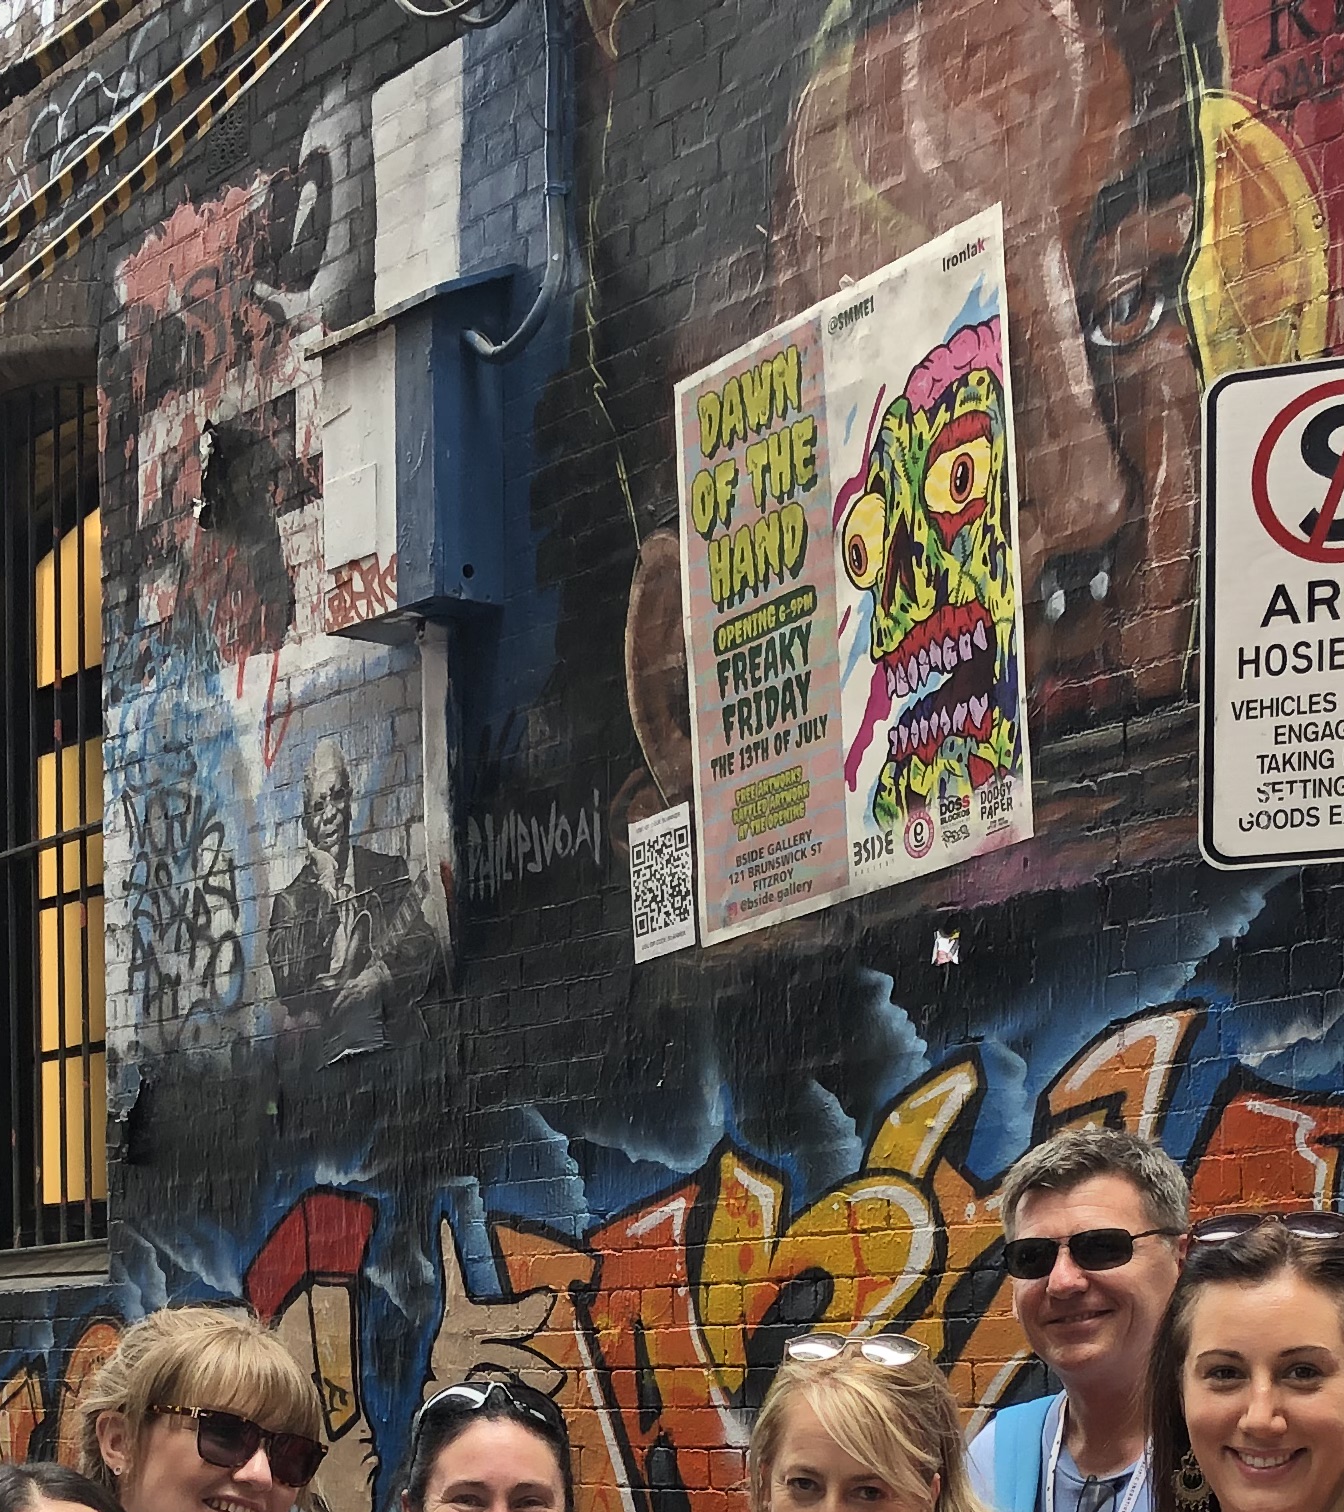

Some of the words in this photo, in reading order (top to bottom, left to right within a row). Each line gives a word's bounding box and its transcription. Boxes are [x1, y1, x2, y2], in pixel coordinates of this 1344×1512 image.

[941, 237, 986, 272] Ironlak
[697, 344, 802, 459] DAWN
[691, 457, 739, 540] OF
[745, 416, 818, 513] THE
[708, 502, 808, 613] HAND
[718, 605, 776, 651] OPENING
[717, 619, 813, 702] FREAKY
[722, 669, 812, 747] FRIDAY
[1231, 692, 1337, 721] VEHICLES
[710, 751, 735, 781] THE
[739, 736, 769, 771] 13TH
[773, 729, 791, 756] OF
[795, 713, 828, 749] JULY
[1256, 748, 1335, 775] TAKING
[734, 781, 757, 807] FREE
[756, 765, 803, 797] ARTWORKS
[980, 780, 1013, 806] DODGY
[767, 801, 807, 831] OPENING
[939, 794, 971, 817] DOSS
[980, 796, 1014, 821] PAPER
[1239, 806, 1321, 832] GOODS
[728, 869, 745, 886] 121
[747, 847, 808, 879] BRUNSWICK
[810, 841, 824, 858] ST
[735, 846, 765, 868] BSIDE
[767, 828, 813, 856] GALLERY
[739, 891, 775, 913] @bside
[777, 879, 813, 903] gallery
[752, 867, 795, 892] FITZROY
